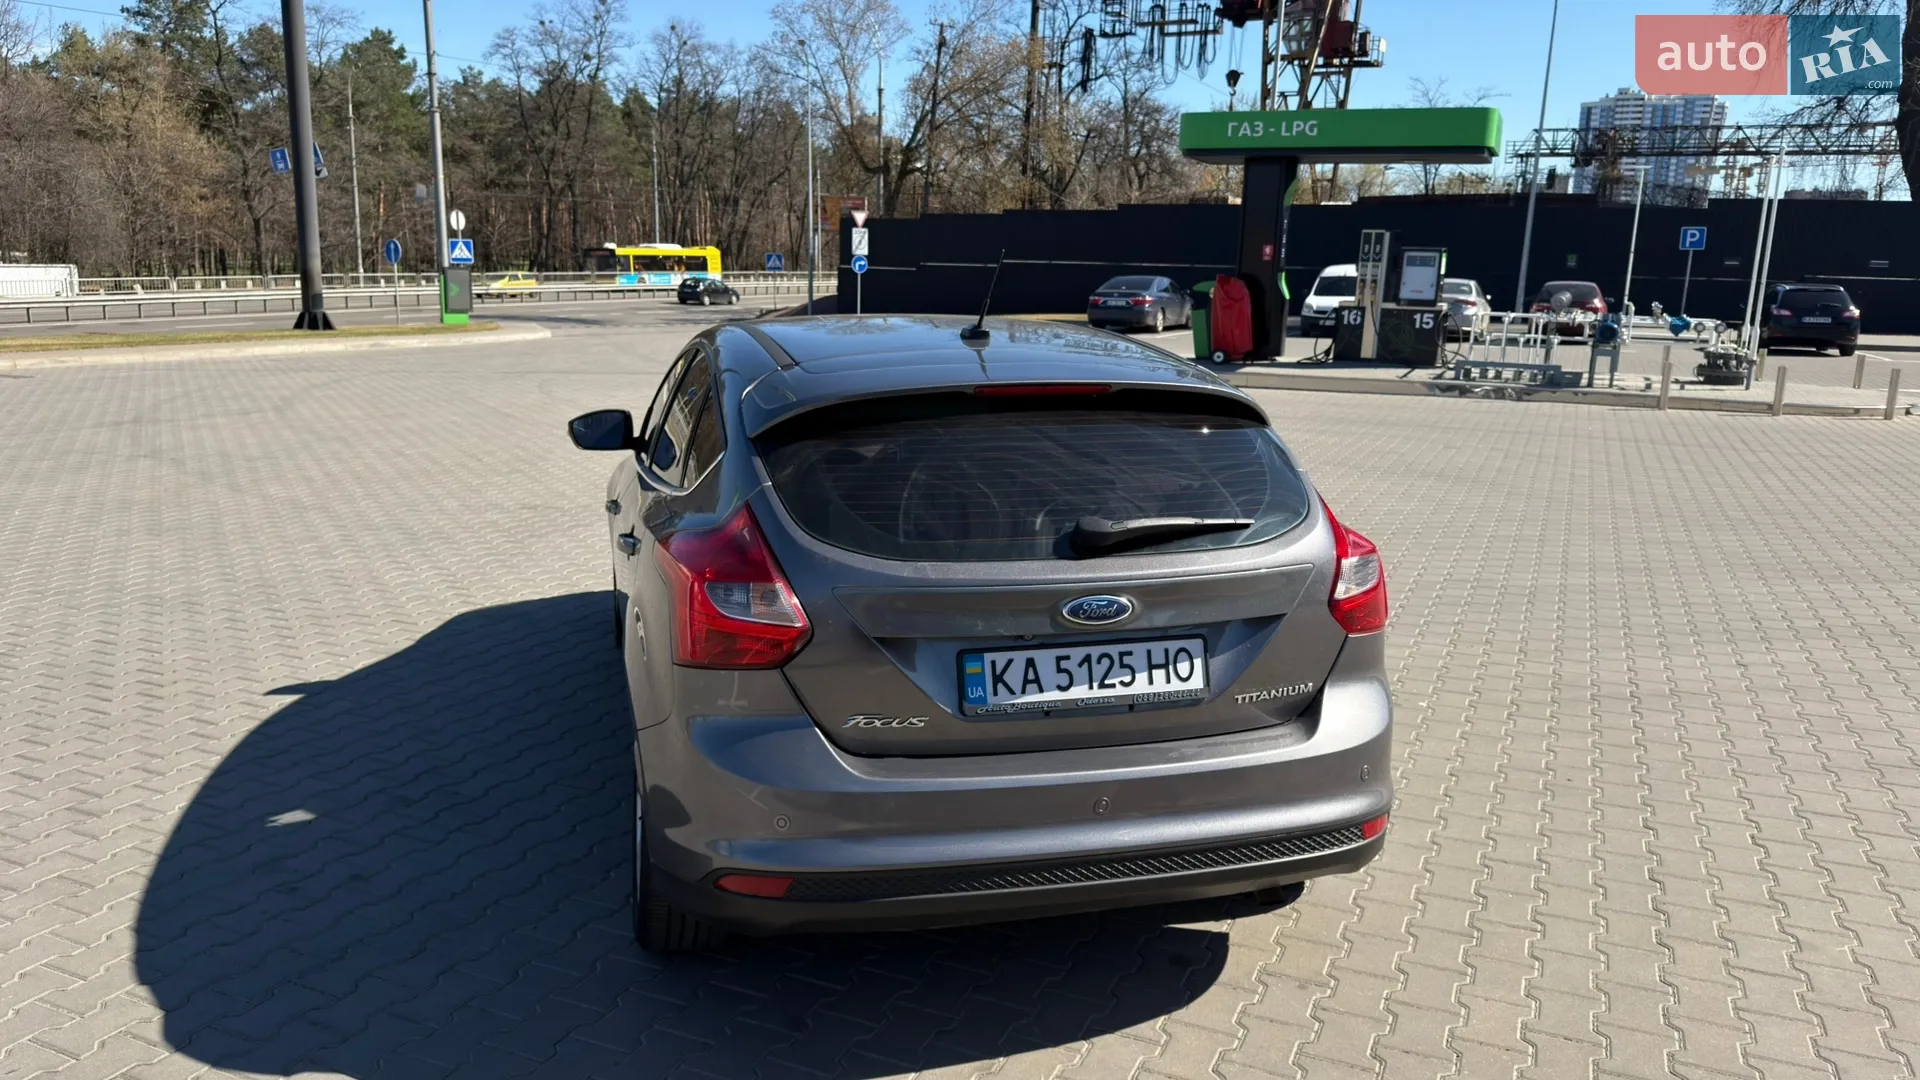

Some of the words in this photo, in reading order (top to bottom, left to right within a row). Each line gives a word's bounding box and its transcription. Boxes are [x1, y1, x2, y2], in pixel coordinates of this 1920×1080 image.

[1227, 121, 1264, 137] ГАЗ
[1280, 120, 1318, 136] LPG
[1686, 230, 1700, 248] P
[1341, 309, 1361, 325] 16
[1413, 313, 1434, 329] 15
[1080, 600, 1118, 617] Ford
[990, 657, 1044, 697] KA
[1055, 651, 1136, 692] 5125
[1147, 647, 1195, 686] HO
[968, 688, 984, 699] UA
[1234, 682, 1313, 704] TITANIUM
